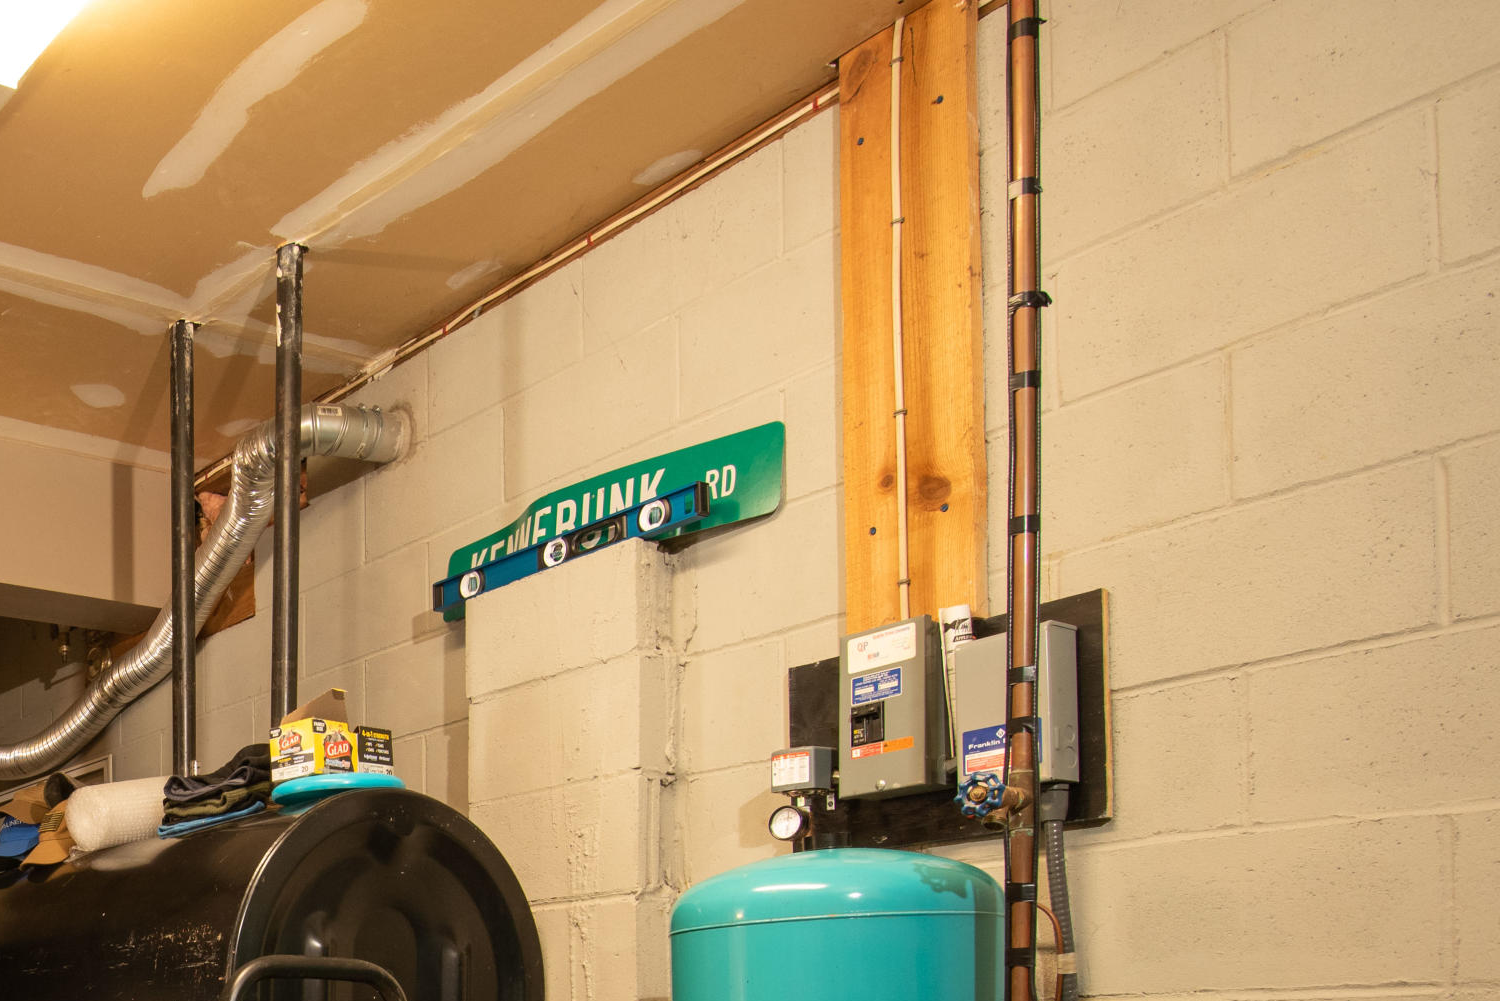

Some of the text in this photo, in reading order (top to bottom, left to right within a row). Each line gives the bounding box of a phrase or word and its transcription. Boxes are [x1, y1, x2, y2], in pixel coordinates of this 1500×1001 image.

[705, 464, 736, 500] RD
[281, 735, 299, 748] GLAD
[968, 739, 1001, 750] Franklin
[327, 743, 349, 756] GLAD
